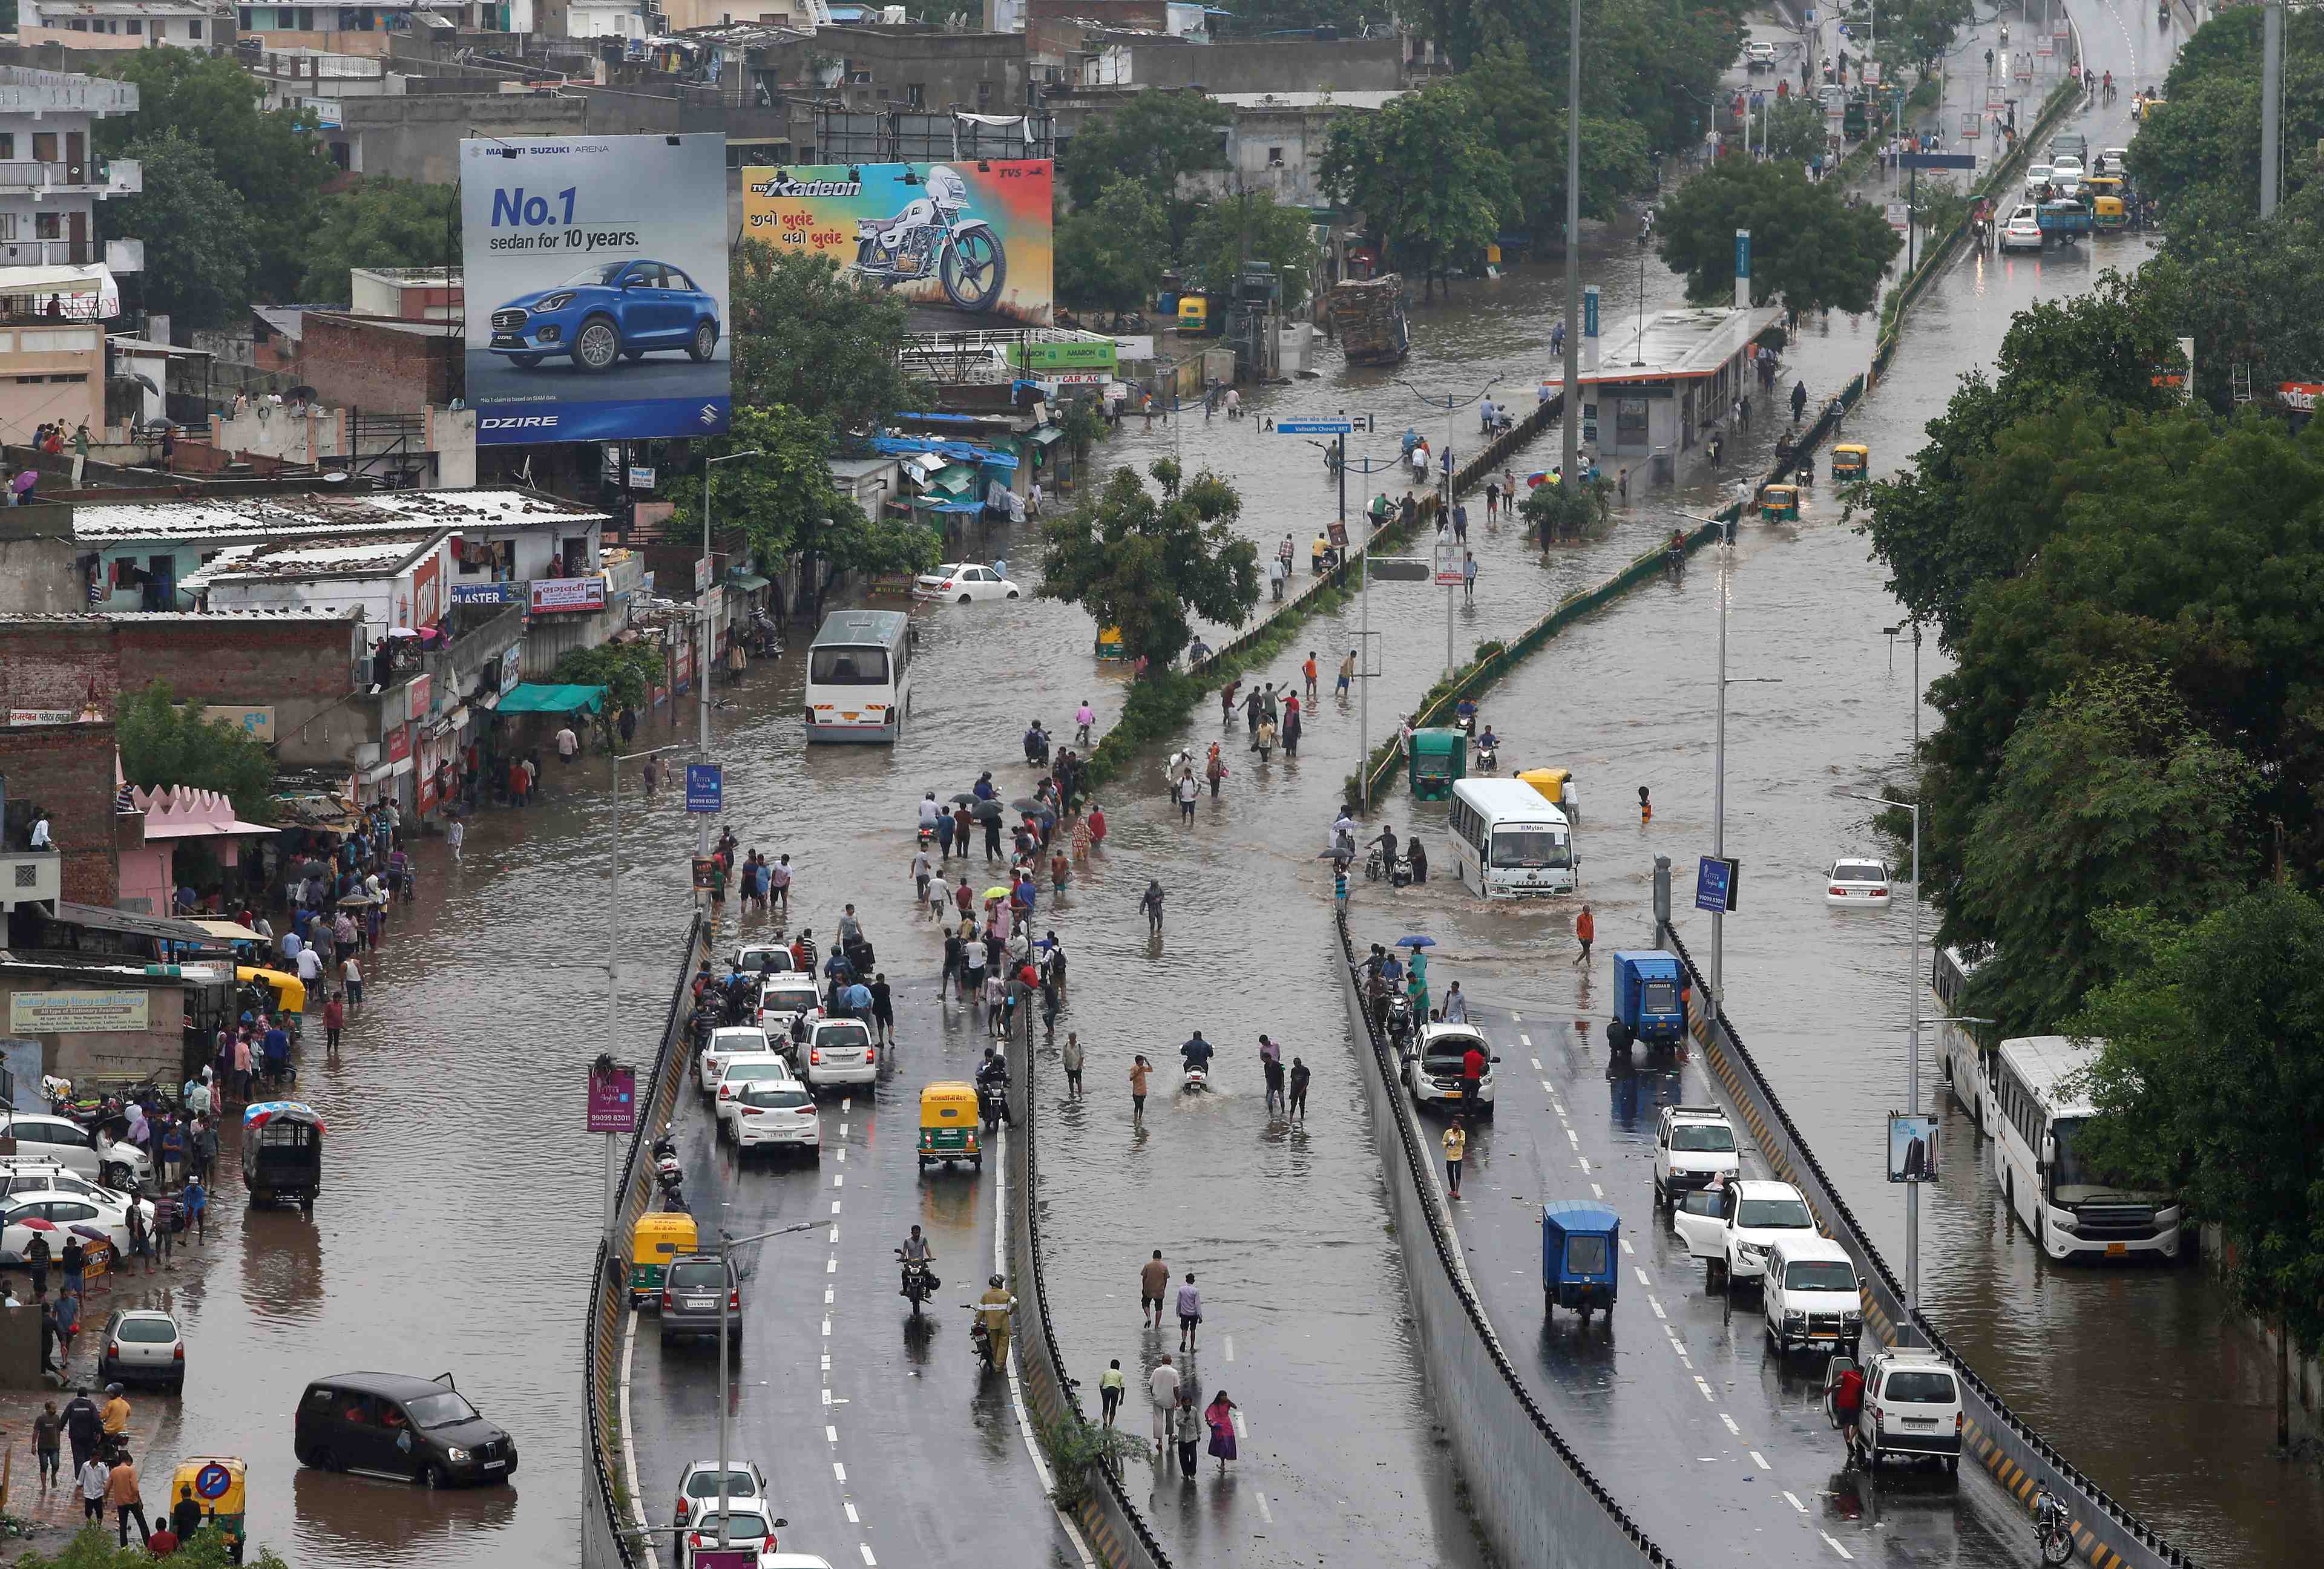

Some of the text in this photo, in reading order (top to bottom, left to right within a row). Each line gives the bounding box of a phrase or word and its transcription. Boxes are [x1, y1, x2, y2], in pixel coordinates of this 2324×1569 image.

[999, 168, 1022, 178] TVS
[763, 177, 861, 197] Radeon
[491, 186, 576, 227] No.1
[750, 210, 814, 230] જીવો બુલંદ
[490, 230, 639, 251] sedan for 10 years.
[812, 228, 842, 249] બુલંદ
[481, 416, 558, 428] DZIRE
[416, 574, 436, 629] SERVO
[451, 592, 499, 603] PLASTER
[10, 712, 36, 721] राजस्थान
